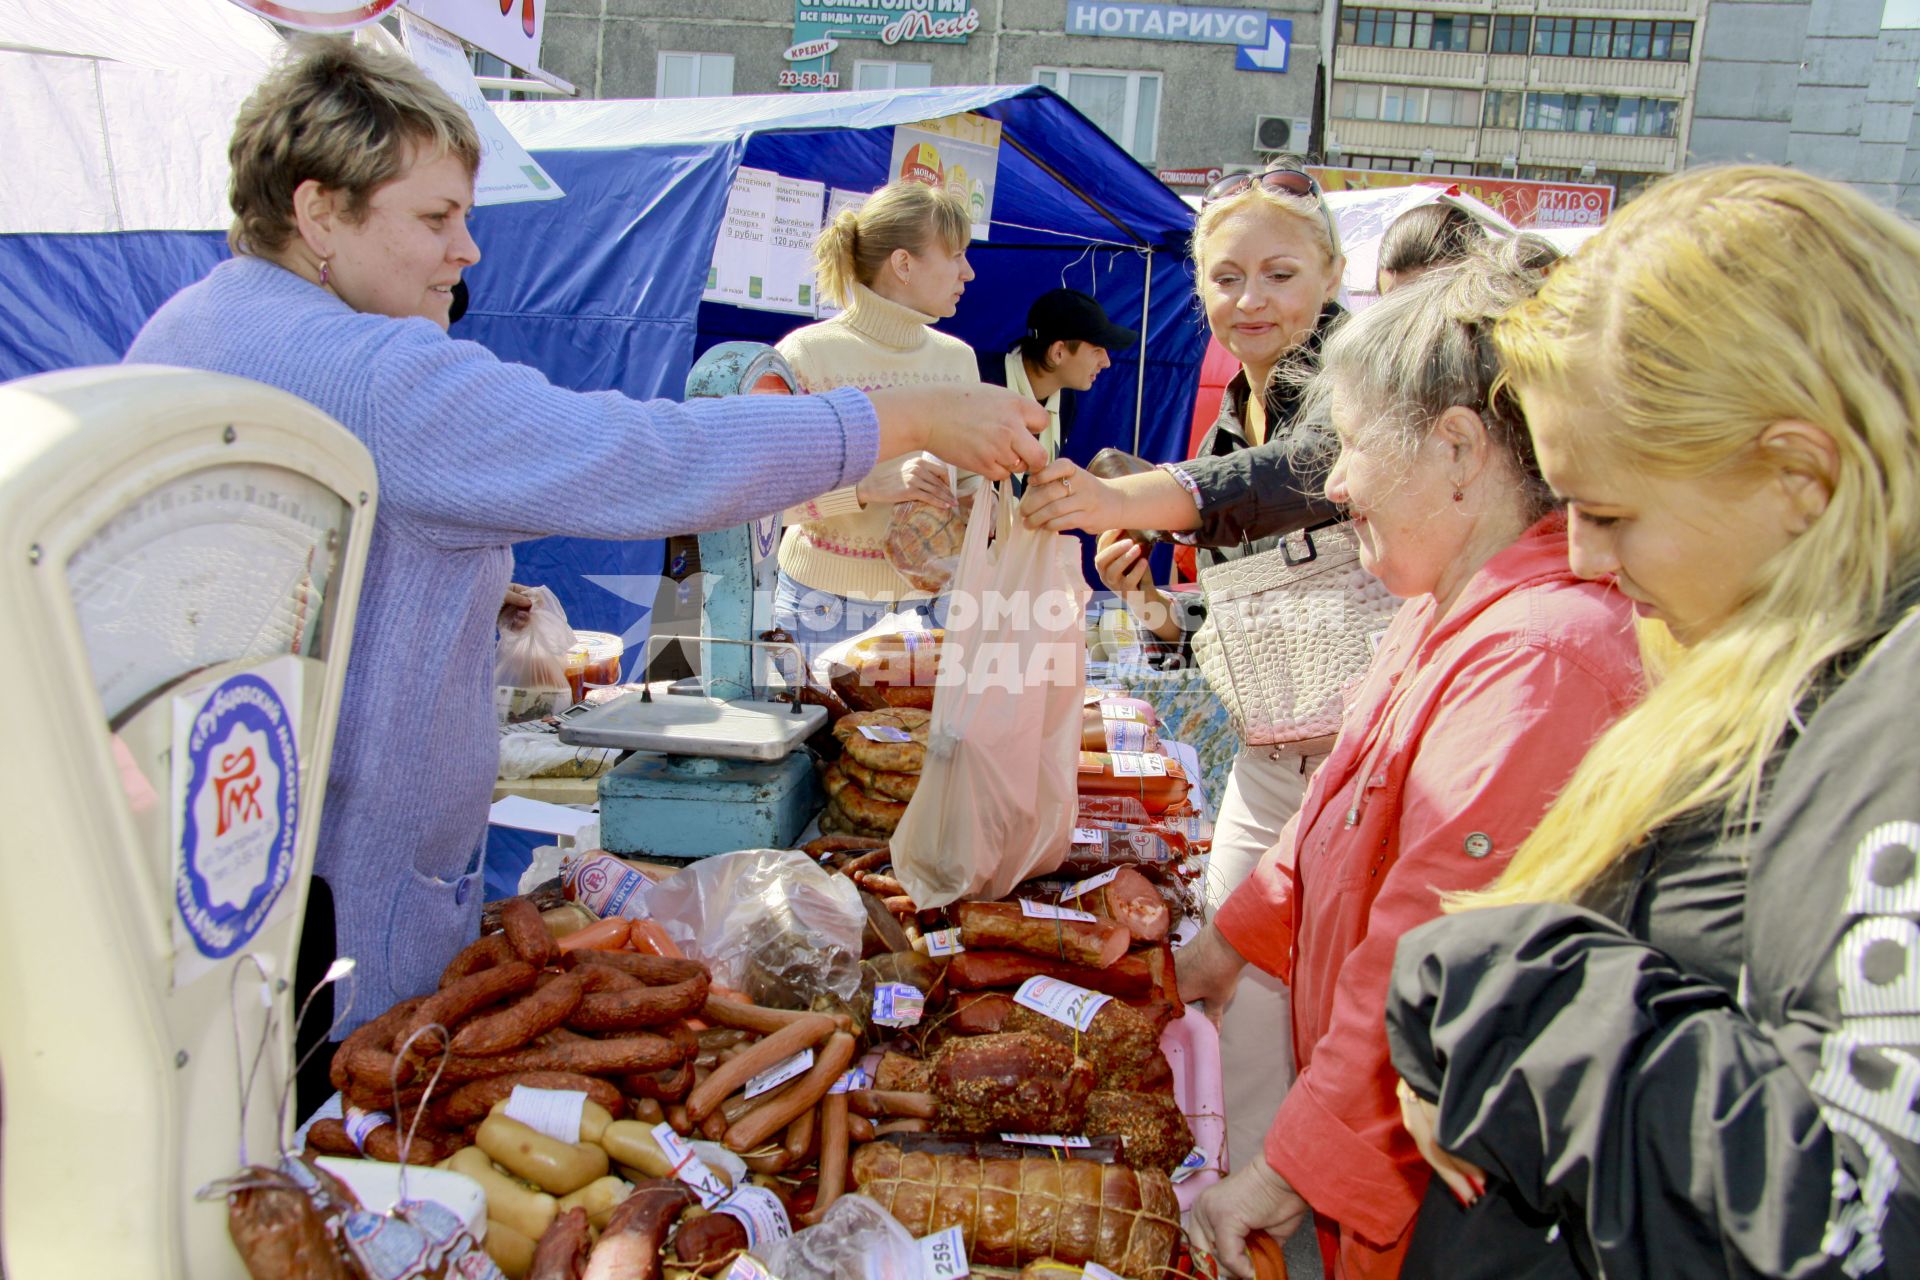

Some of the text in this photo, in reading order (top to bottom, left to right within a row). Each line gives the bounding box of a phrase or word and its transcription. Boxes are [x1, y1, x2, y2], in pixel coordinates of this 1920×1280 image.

[800, 11, 889, 26] ВСЕ ВИДЫ УСЛУГ
[1075, 6, 1259, 40] НОТАРИУС
[791, 41, 830, 59] КРЕДИТ
[780, 73, 838, 87] 23-58-41
[912, 166, 938, 184] МОНАР
[607, 871, 641, 917] ОКТОРСКАЯ
[932, 1243, 954, 1275] 259
